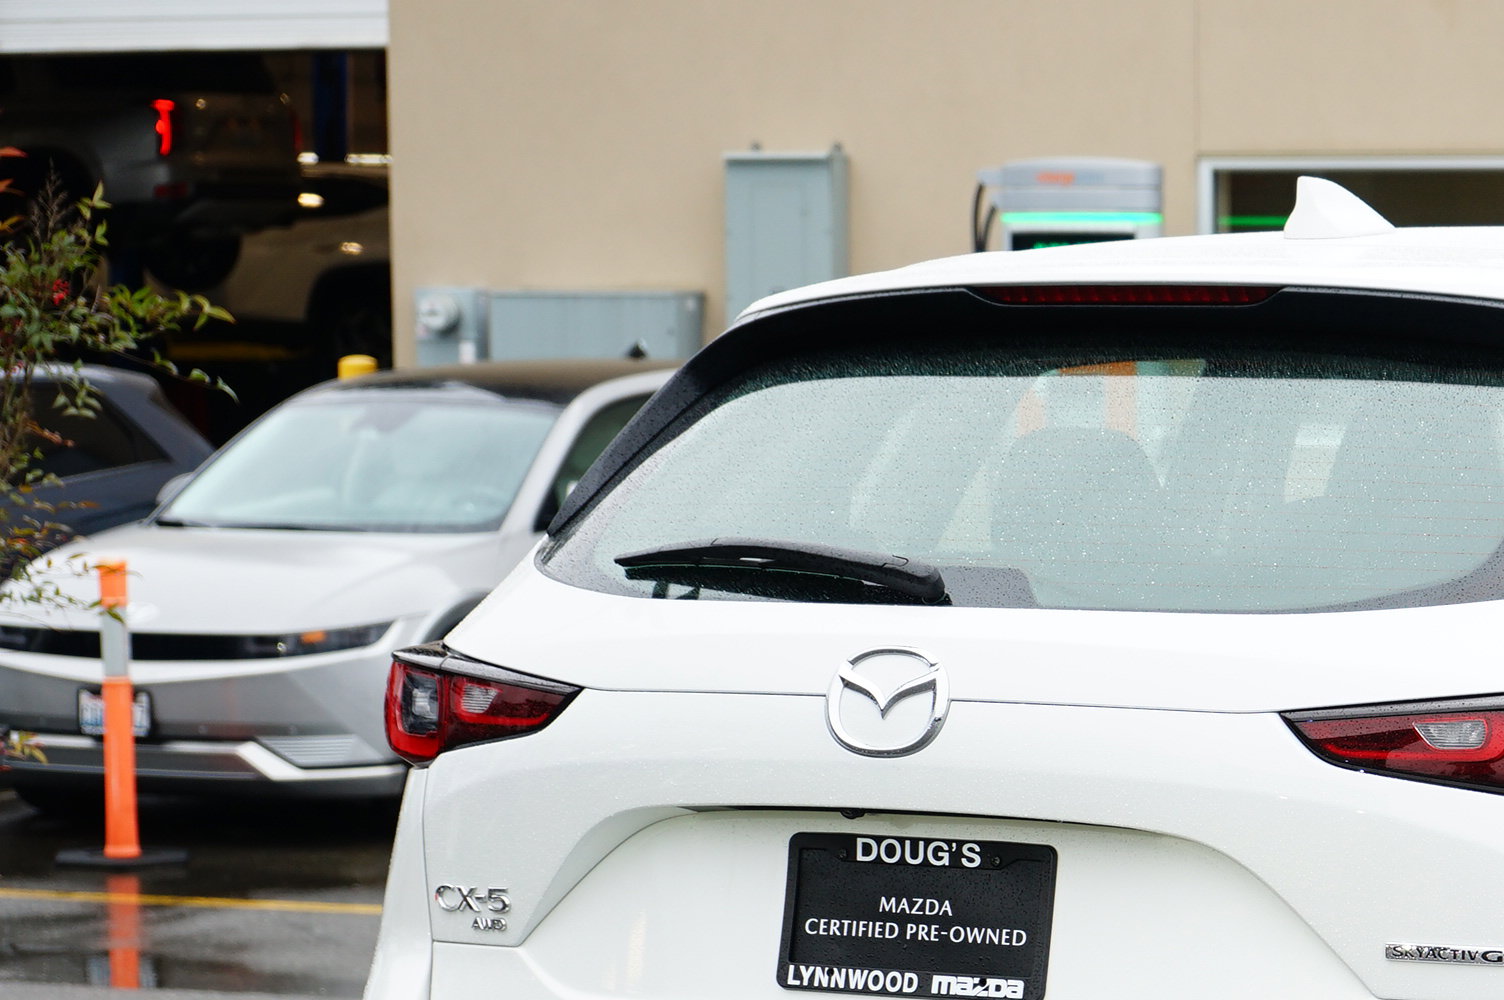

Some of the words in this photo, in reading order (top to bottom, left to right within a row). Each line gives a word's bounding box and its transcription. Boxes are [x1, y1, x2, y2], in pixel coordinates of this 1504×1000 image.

[856, 837, 982, 868] DOUG'S
[434, 884, 512, 914] CX-5
[878, 896, 953, 917] MAZDA
[804, 918, 899, 940] CERTIFIED
[905, 922, 1027, 947] PRE-OWNED
[786, 964, 919, 993] LYNNWOOD
